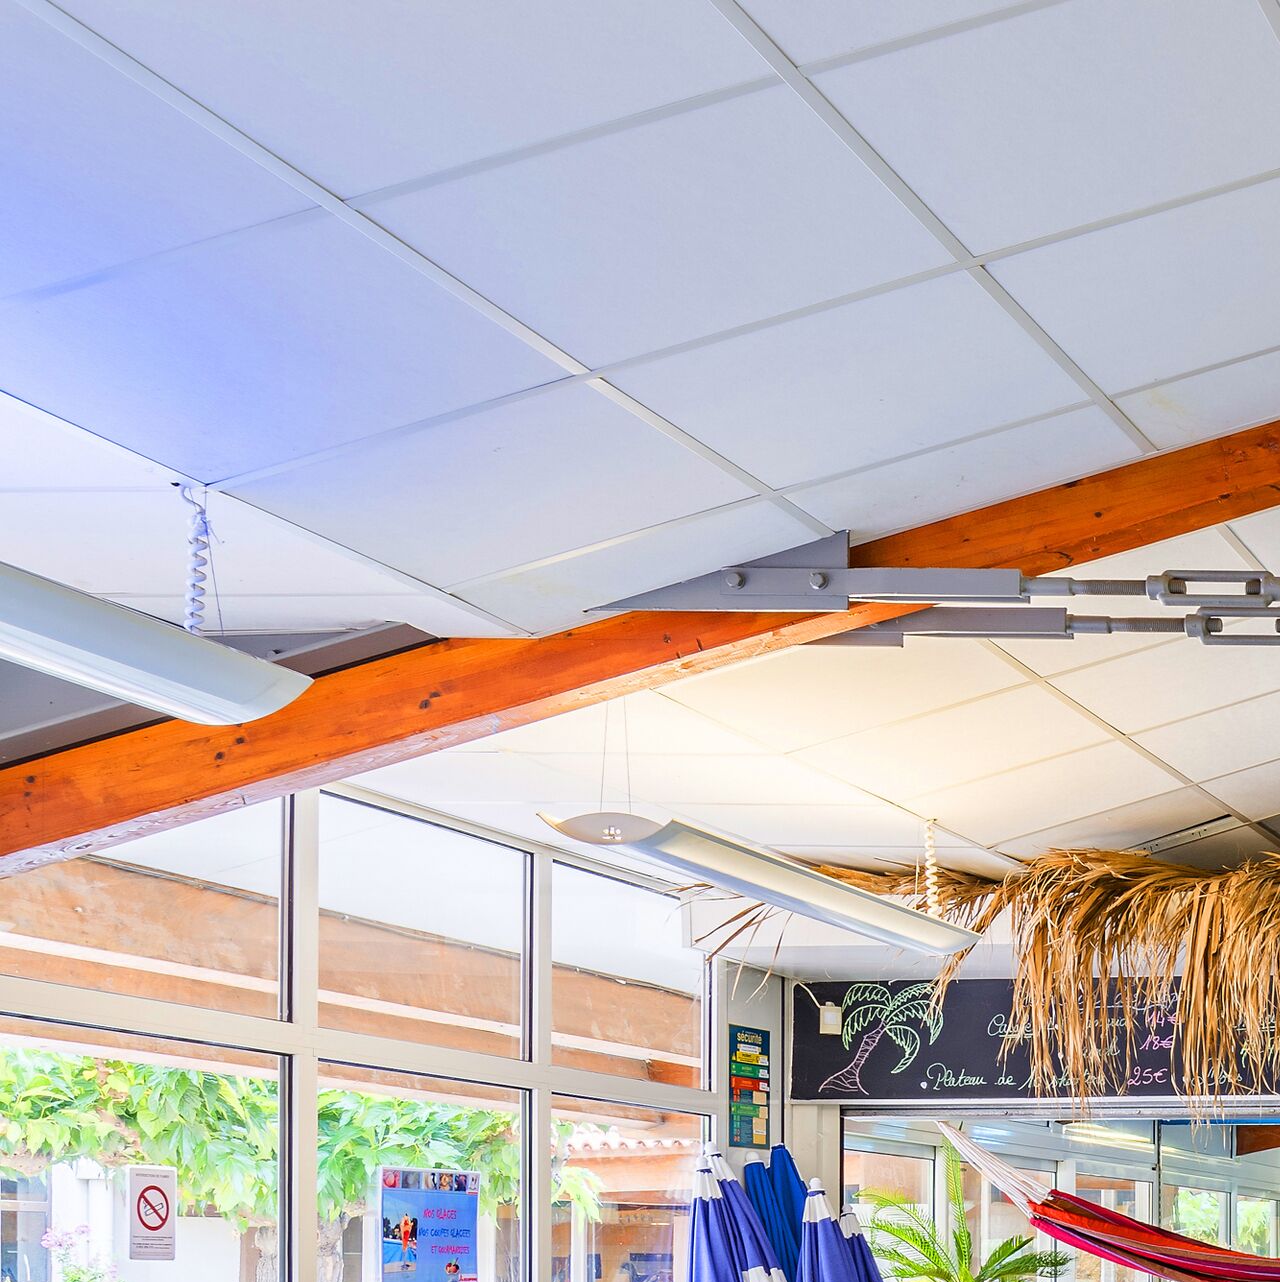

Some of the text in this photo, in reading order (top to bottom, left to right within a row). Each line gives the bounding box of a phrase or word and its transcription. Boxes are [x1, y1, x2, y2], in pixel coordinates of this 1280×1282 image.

[927, 1063, 987, 1090] Plateau
[994, 1073, 1016, 1085] de
[1127, 1067, 1168, 1087] 25€
